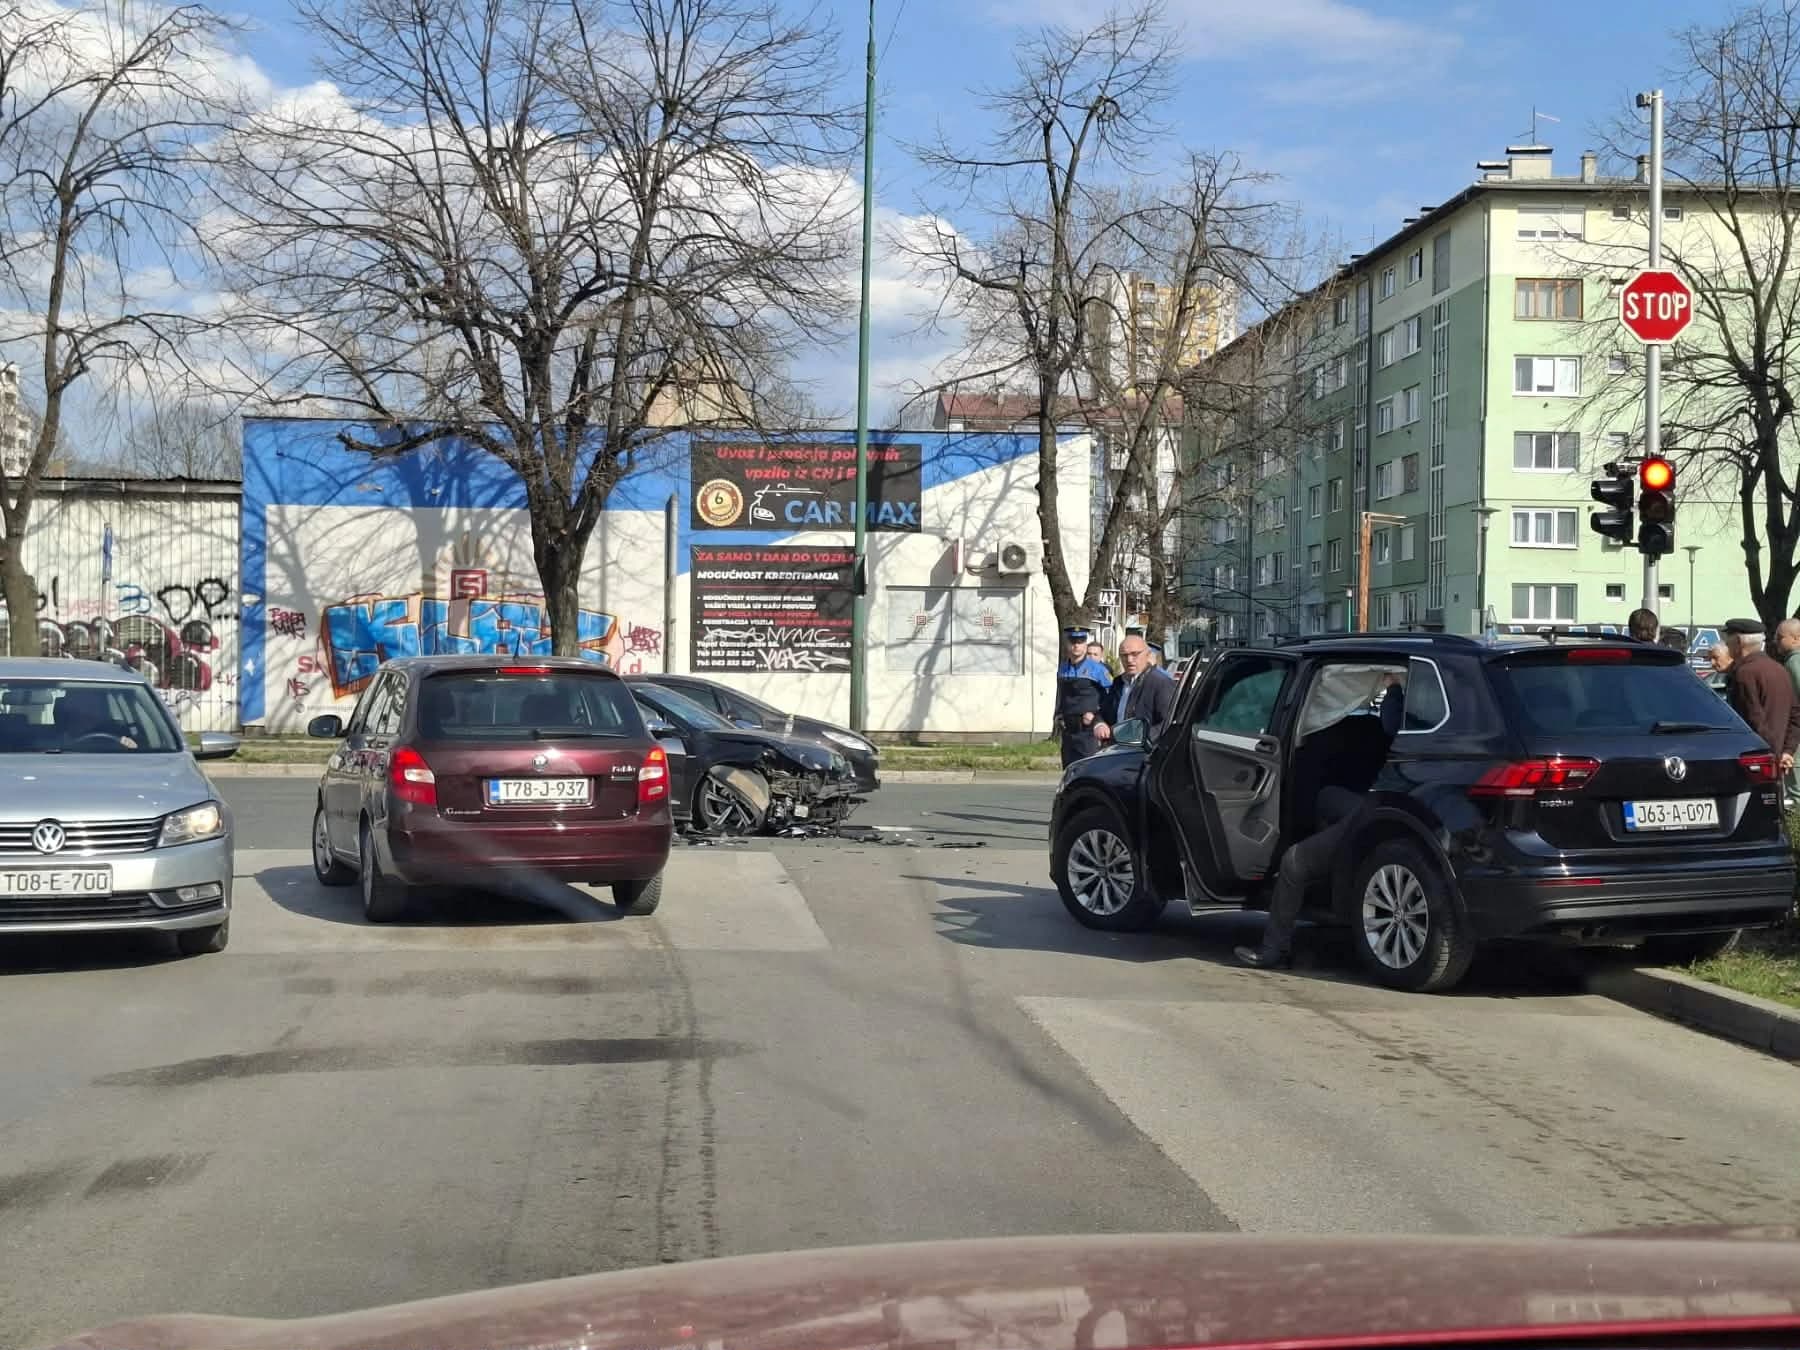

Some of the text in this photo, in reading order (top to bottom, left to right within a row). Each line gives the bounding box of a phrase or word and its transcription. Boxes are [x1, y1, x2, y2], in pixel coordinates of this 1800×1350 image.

[1626, 291, 1688, 321] STOP
[716, 447, 755, 460] Uvoz
[831, 446, 901, 462] polvnih
[784, 500, 843, 524] CAR
[717, 551, 752, 562] SAMO
[763, 552, 789, 562] DAN
[792, 552, 810, 563] DO
[503, 781, 586, 798] T78-J-937
[1637, 802, 1714, 824] J63-A-097
[4, 872, 109, 892] T08-E-700
